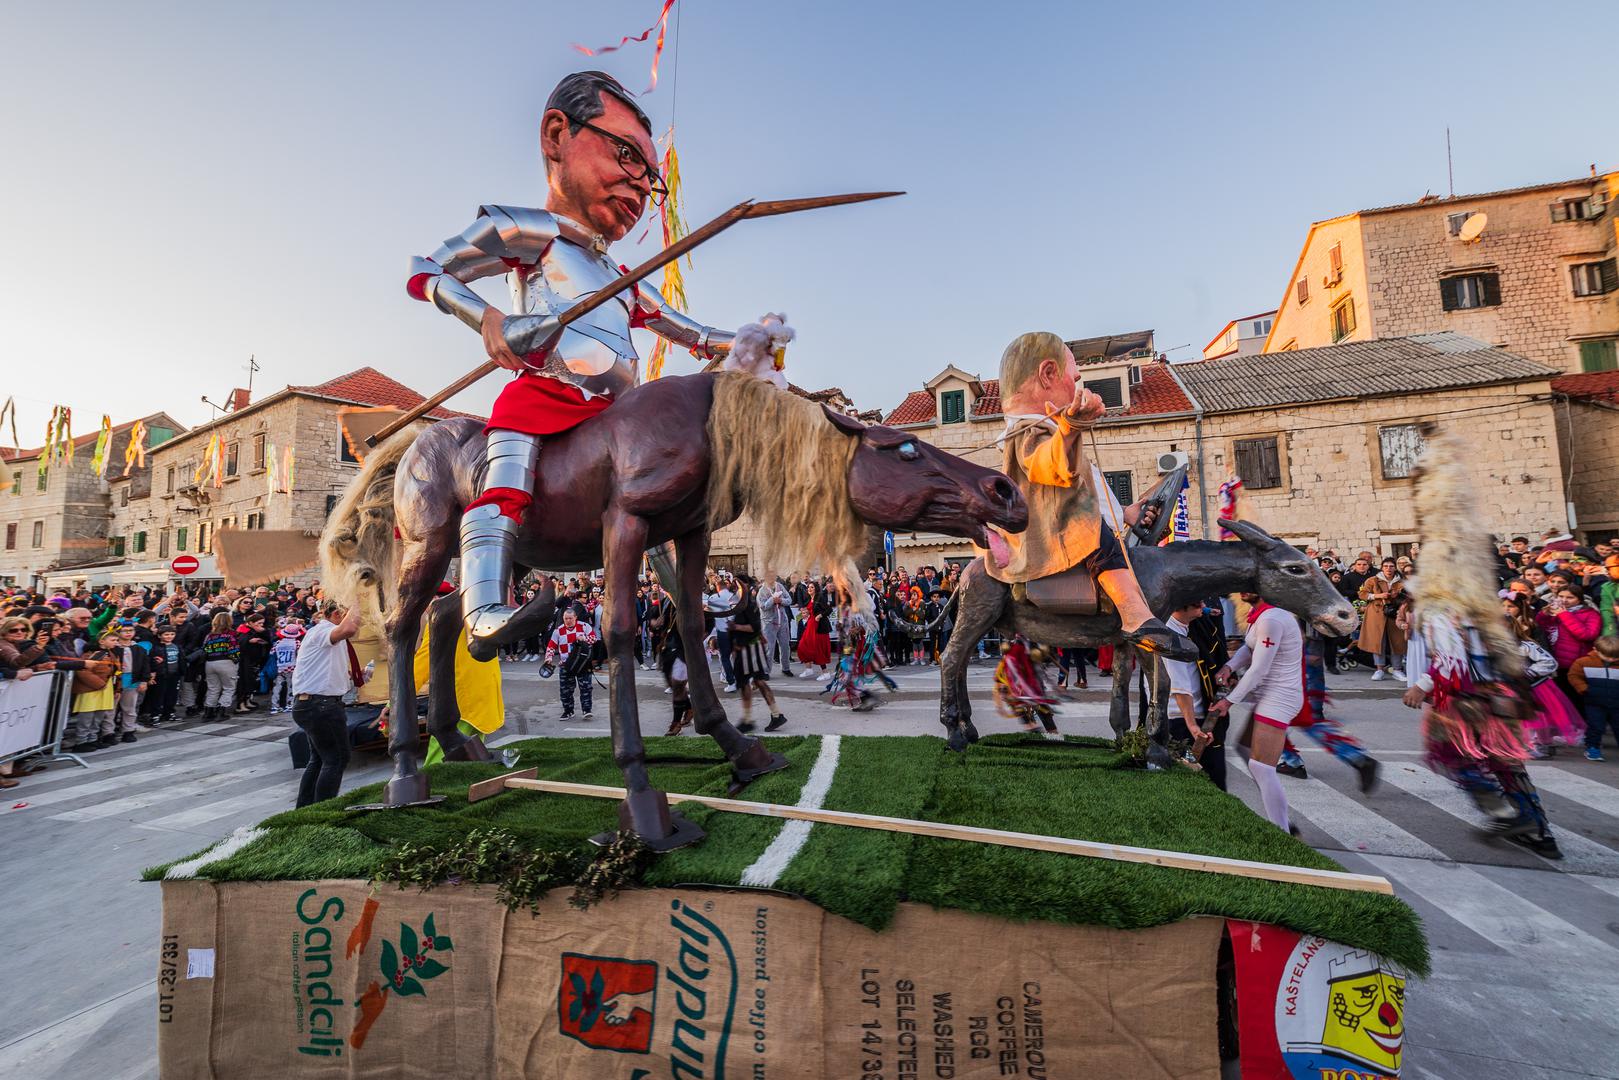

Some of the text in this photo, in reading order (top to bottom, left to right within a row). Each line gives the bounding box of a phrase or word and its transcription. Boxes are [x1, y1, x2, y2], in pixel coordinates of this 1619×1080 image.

[292, 931, 304, 1034] italian coffee passion
[296, 888, 345, 1057] Sandalj
[751, 907, 771, 981] passion
[631, 899, 739, 1080] andalj
[748, 988, 766, 1054] coffee
[861, 968, 881, 1009] LOT
[932, 992, 955, 1080] WASHED
[968, 1016, 991, 1059] RGG
[996, 995, 1020, 1076] COFFEE
